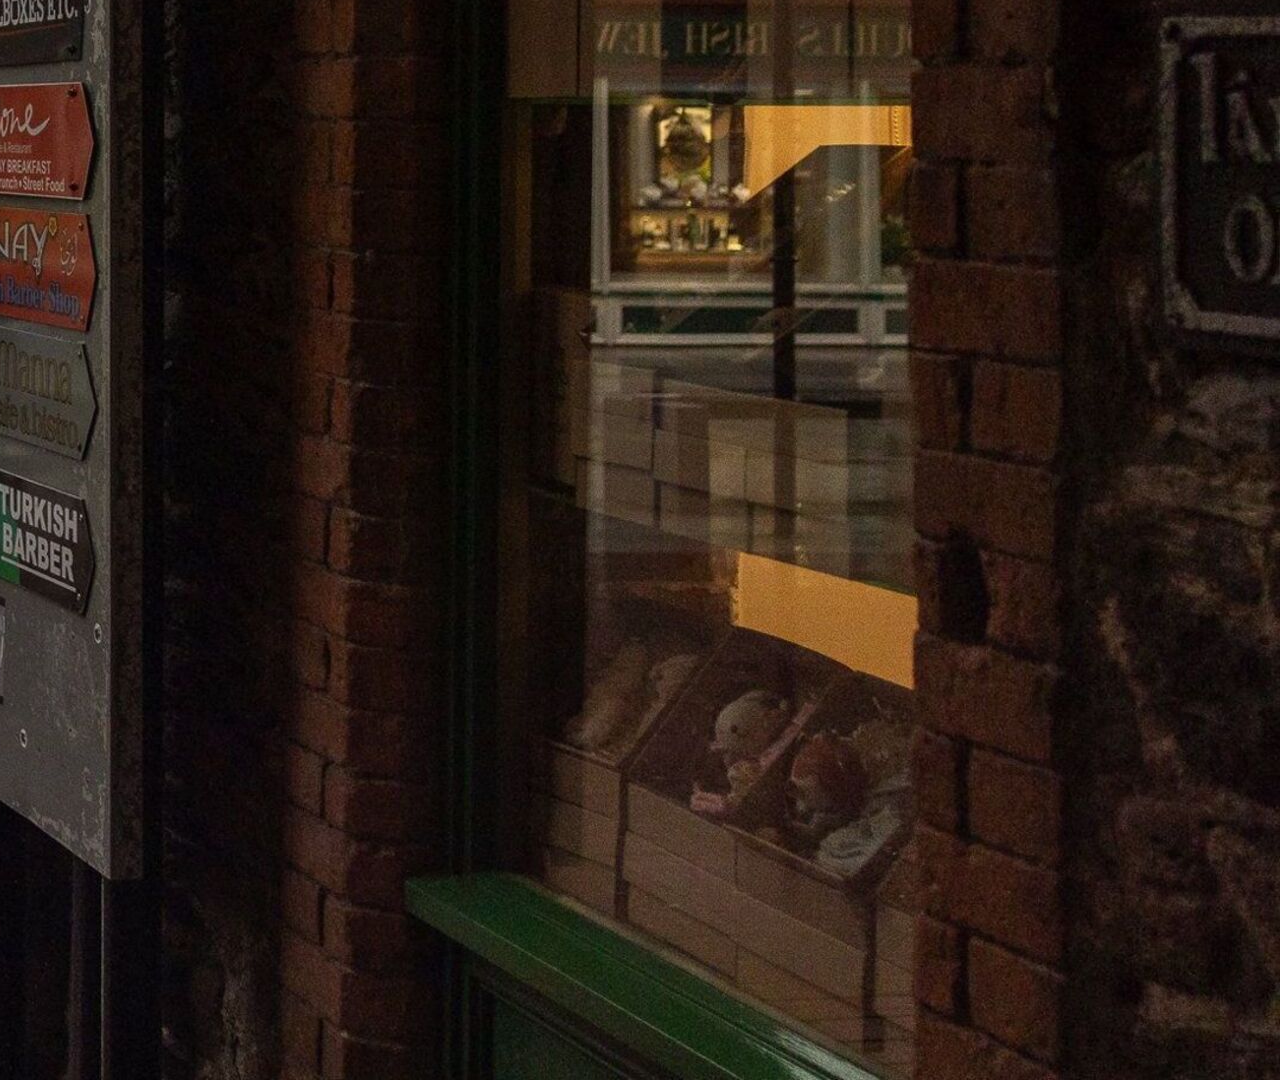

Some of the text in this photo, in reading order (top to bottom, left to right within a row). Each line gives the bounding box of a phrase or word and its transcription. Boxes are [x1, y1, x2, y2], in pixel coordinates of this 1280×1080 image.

[7, 159, 52, 174] BREAKFAST
[22, 176, 44, 191] Street
[45, 177, 65, 192] Food
[6, 277, 45, 308] Barber
[48, 283, 81, 319] Shop
[0, 483, 80, 545] TURKISH
[2, 521, 75, 583] BARBER
